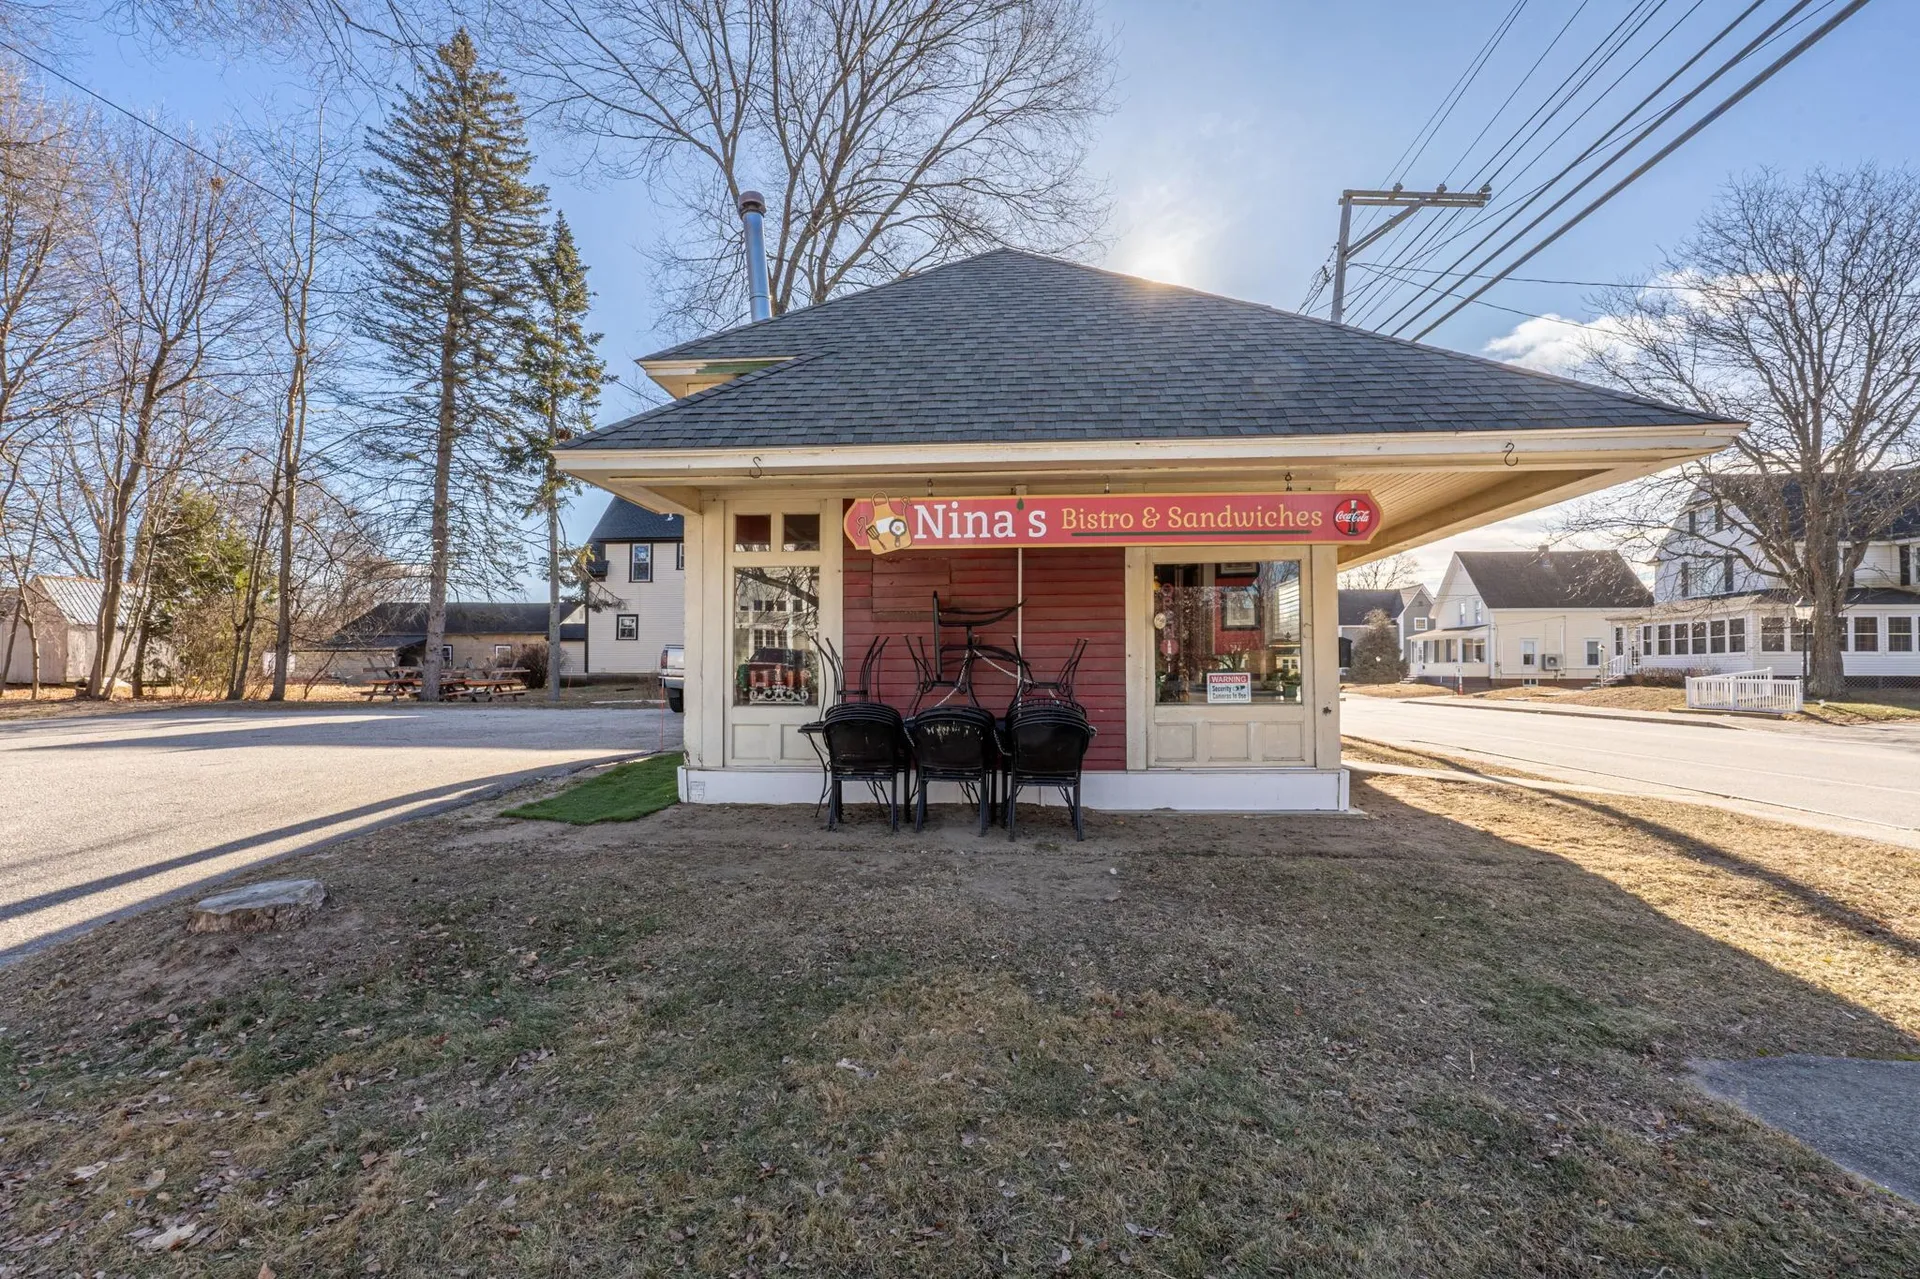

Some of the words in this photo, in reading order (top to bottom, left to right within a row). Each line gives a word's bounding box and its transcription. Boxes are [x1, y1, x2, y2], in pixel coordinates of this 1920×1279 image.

[914, 497, 1047, 539] Nina's
[1061, 508, 1134, 529] Bistro
[1142, 507, 1160, 528] &
[1168, 504, 1322, 528] Sandwiches
[1211, 675, 1247, 683] WARNING
